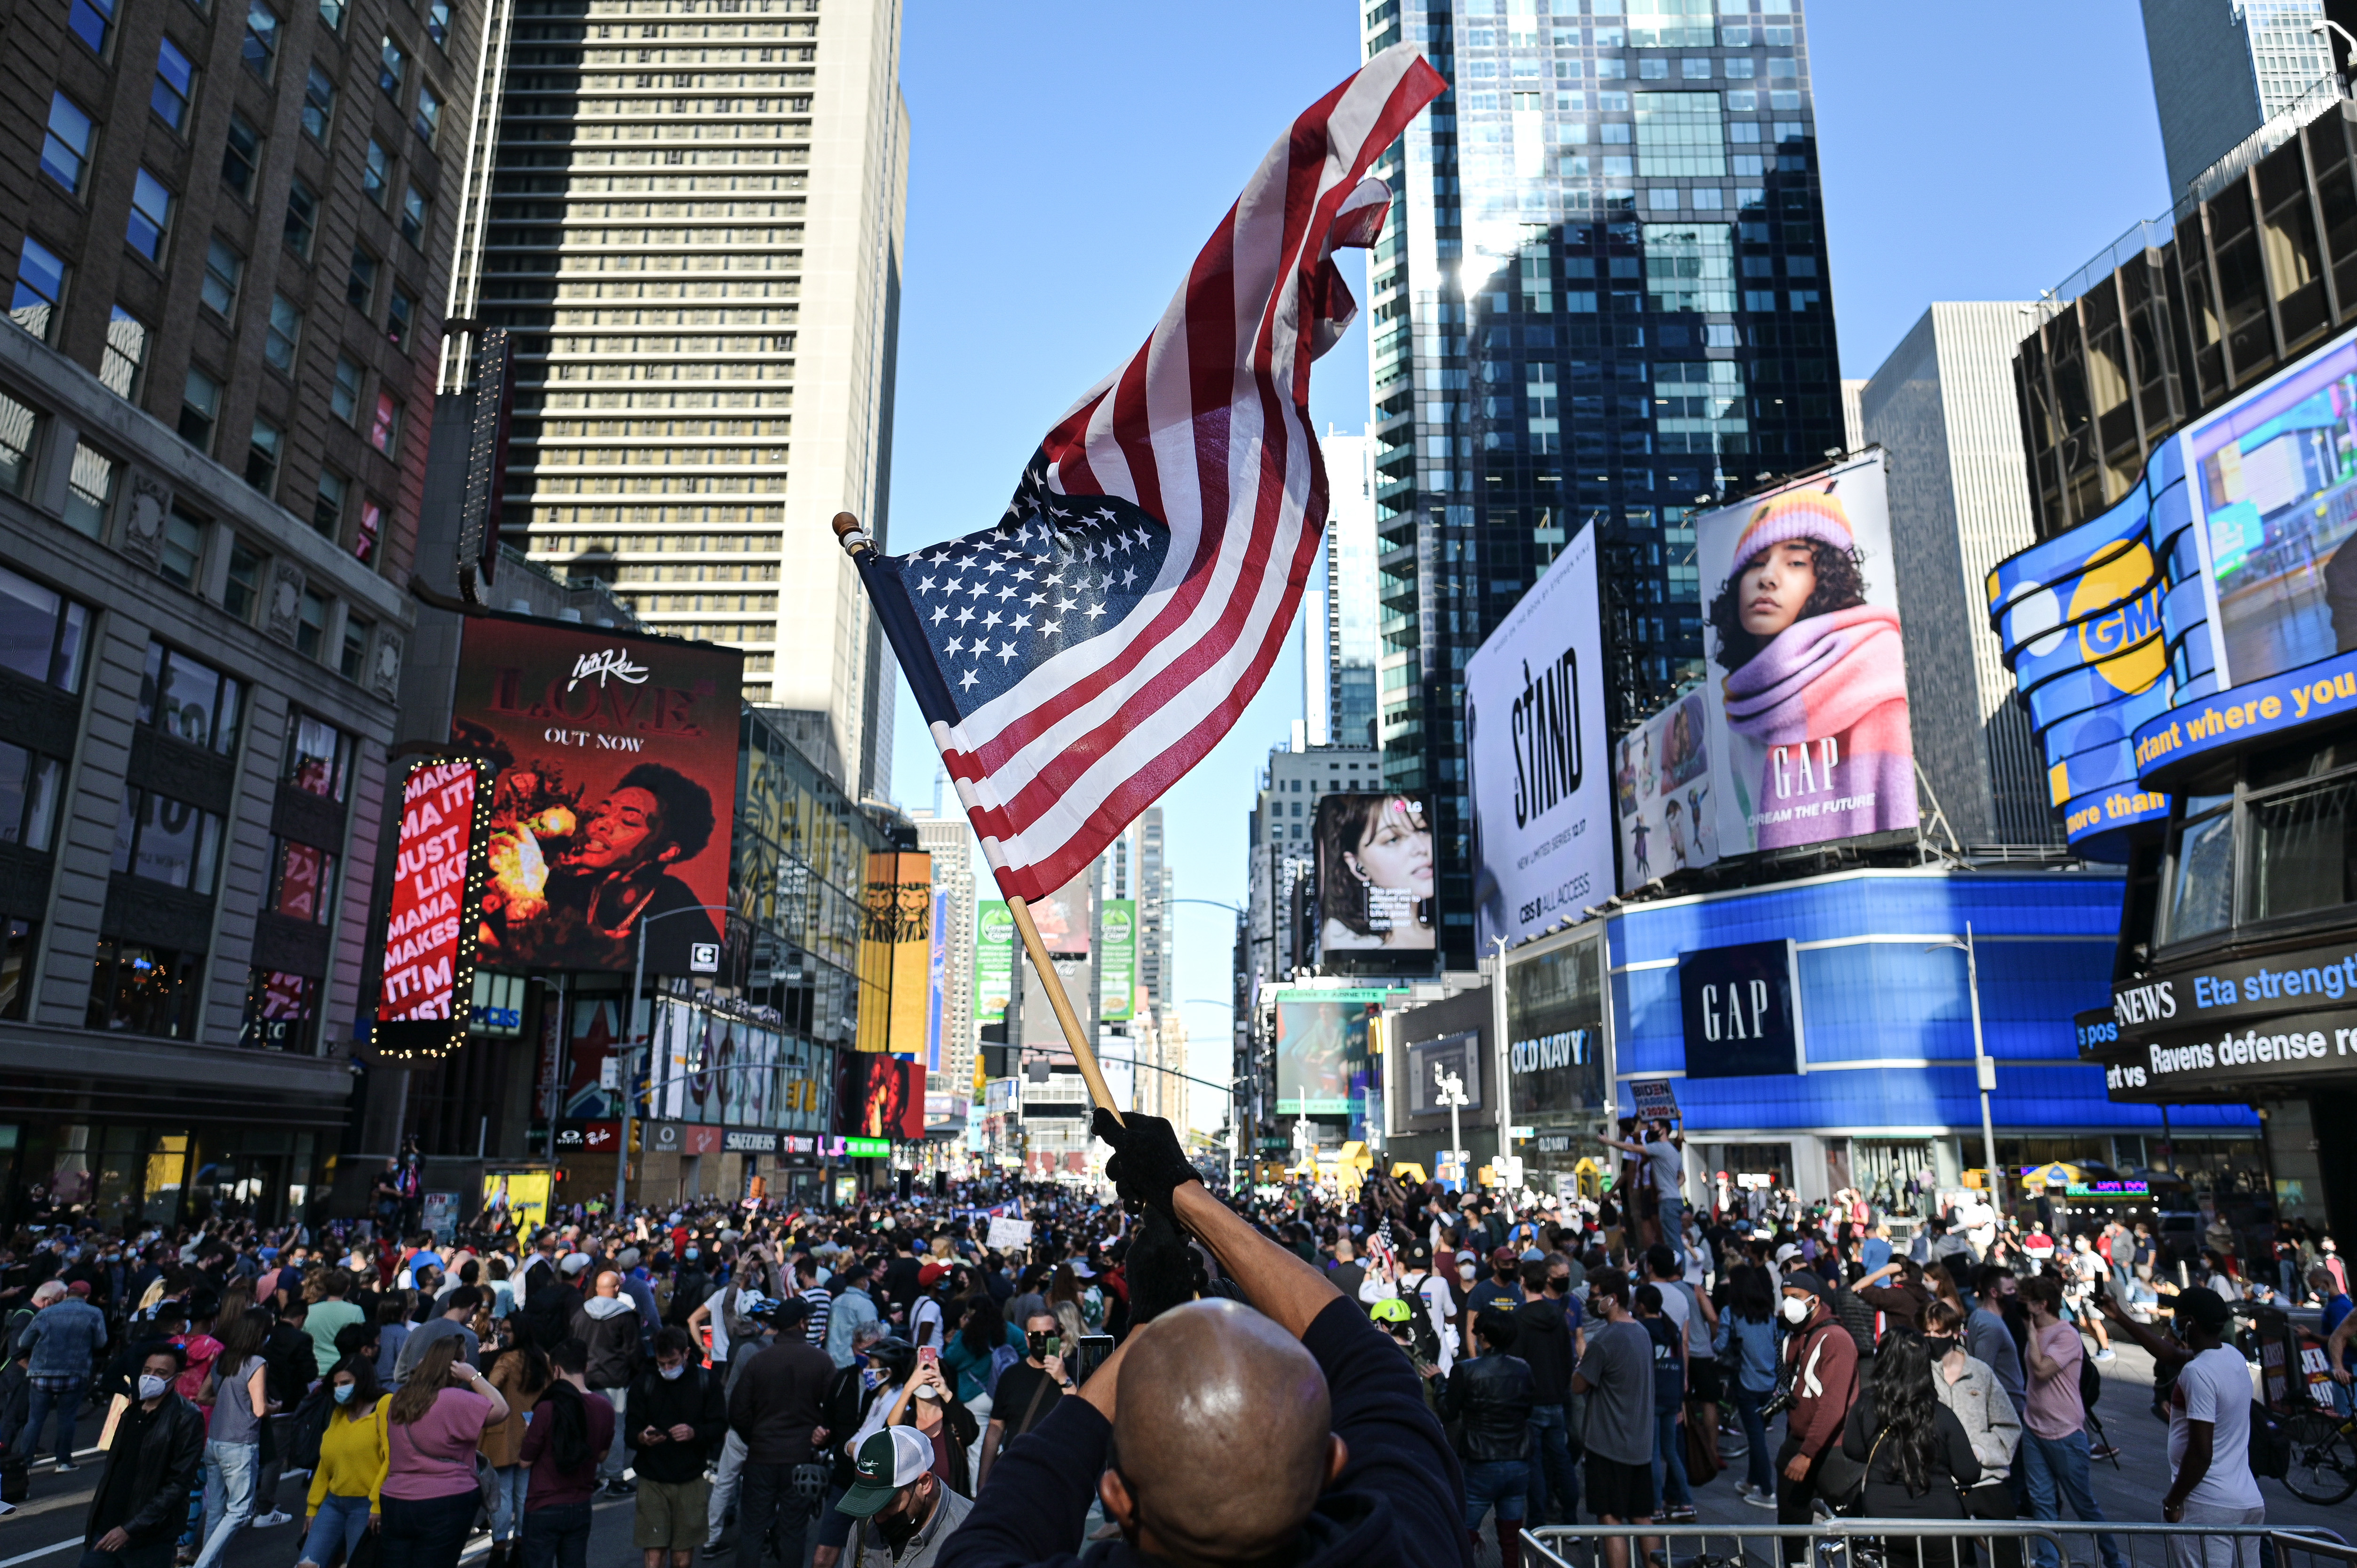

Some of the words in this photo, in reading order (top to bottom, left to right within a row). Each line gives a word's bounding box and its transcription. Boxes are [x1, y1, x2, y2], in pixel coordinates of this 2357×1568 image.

[544, 727, 590, 747] OUT
[596, 733, 644, 753] NOW
[1512, 646, 1583, 830] STAND
[2186, 695, 2282, 742] where
[404, 763, 471, 804] MAKE
[1773, 736, 1839, 800] GAP
[1406, 801, 1422, 812] LG
[1747, 807, 1792, 827] DREAM
[1794, 802, 1820, 819] THE
[1822, 792, 1876, 815] FUTURE
[2105, 792, 2166, 819] than
[394, 824, 460, 882] JUST
[387, 891, 458, 942] MAMA
[1519, 901, 1536, 925] CBS
[1558, 871, 1591, 904] ACCESS
[383, 916, 460, 973] MAKES
[385, 964, 422, 1004] IT!
[422, 955, 453, 995] M
[2193, 975, 2238, 1009] Eta
[2243, 953, 2357, 1001] strengt
[1702, 979, 1768, 1042] GAP
[2115, 981, 2177, 1027] NEWS
[1511, 1038, 1539, 1075] OLD
[1539, 1028, 1587, 1071] NAVY
[2087, 1021, 2119, 1050] pos
[2122, 1066, 2147, 1088] vs
[2149, 1042, 2216, 1075] Ravens
[2217, 1029, 2328, 1067] defense
[1633, 1083, 1670, 1097] BIDEN
[1647, 1106, 1669, 1117] 2020
[1538, 1137, 1551, 1152] OLD
[1552, 1136, 1569, 1152] NAVY
